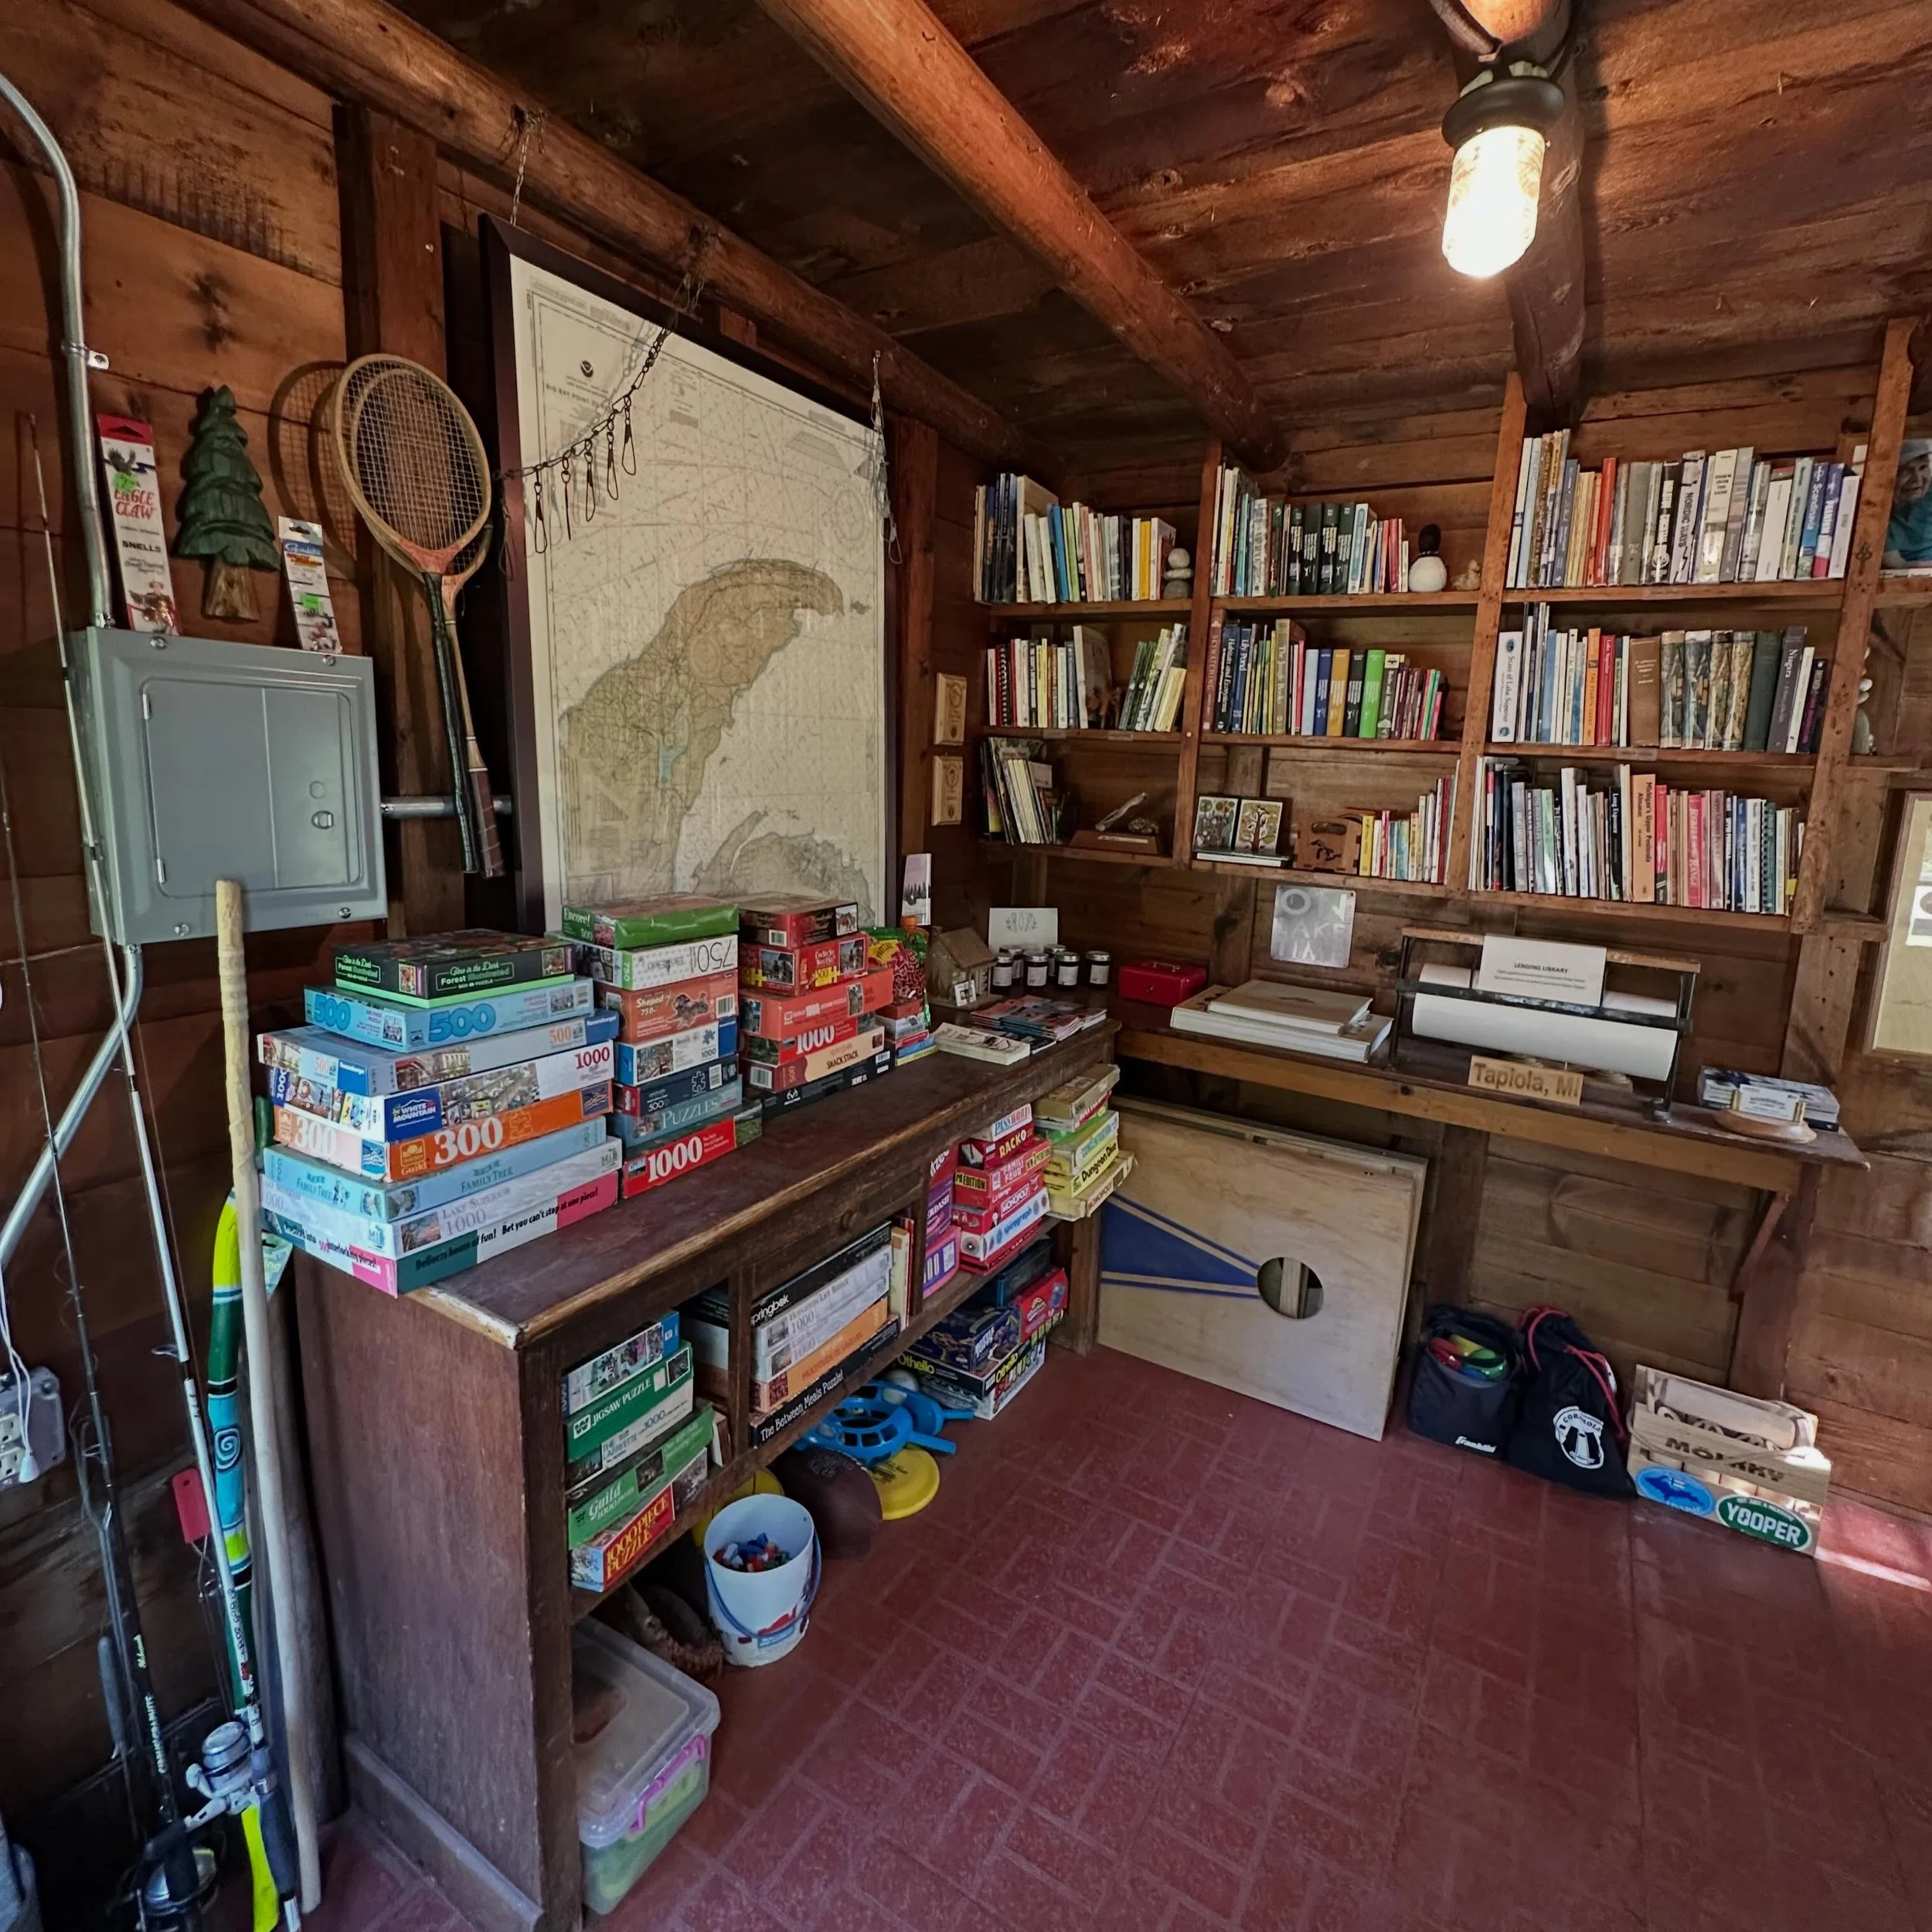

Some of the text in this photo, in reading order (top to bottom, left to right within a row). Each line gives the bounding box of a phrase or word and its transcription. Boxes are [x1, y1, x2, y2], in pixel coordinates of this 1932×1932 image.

[116, 501, 154, 519] CLAW
[1678, 492, 1694, 548] NORDIC WAYS
[1807, 483, 1822, 530] Scandinavia
[122, 540, 161, 553] SNELLS
[1207, 634, 1219, 690] SKYWATCHING
[1240, 652, 1248, 671] Pond
[1784, 648, 1798, 679] Niagara
[1690, 808, 1699, 839] REBELS
[563, 907, 590, 926] Encore!
[697, 940, 733, 973] 750
[1514, 963, 1541, 971] LENDING
[440, 975, 466, 985] Forest
[314, 994, 351, 1031] 500
[636, 994, 665, 1009] Shaped
[429, 1003, 496, 1042] 500
[549, 1026, 572, 1042] 500
[701, 1047, 717, 1060] 1000
[796, 1025, 835, 1055] 1000
[574, 1046, 611, 1070] 1000
[826, 1049, 859, 1070] SNACK STACK
[1474, 1062, 1580, 1098] Tapiola, MI
[393, 1106, 437, 1124] MOUNTAIN
[401, 1103, 427, 1115] WHITE
[662, 1097, 719, 1130] PUZZLES
[994, 1105, 1031, 1137] PASSWORD
[294, 1116, 338, 1158] 300
[434, 1117, 503, 1165] 300
[648, 1136, 703, 1183] 1000
[1081, 1143, 1117, 1182] Dungeon Dice
[297, 1178, 318, 1196] FAMILY
[461, 1172, 494, 1192] FAMILY
[493, 1166, 514, 1181] TREE
[963, 1175, 986, 1191] EDITION
[265, 1190, 284, 1209] 000
[469, 1186, 511, 1207] SUPERIOR
[1002, 1185, 1029, 1212] MONOPOLY
[415, 1247, 447, 1271] Delivers
[449, 1240, 471, 1257] hours
[471, 1234, 481, 1248] of
[480, 1229, 497, 1245] fun!
[502, 1223, 515, 1235] Bet
[515, 1218, 528, 1231] you
[529, 1210, 545, 1224] can't
[546, 1204, 560, 1218] stop
[567, 1197, 580, 1206] one
[580, 1187, 599, 1205] piece!
[446, 1209, 487, 1237] 1000
[1004, 1206, 1032, 1235] spirograph
[791, 1309, 815, 1335] 1000
[896, 1353, 935, 1375] Othello
[995, 1352, 1019, 1383] Othello
[592, 1377, 651, 1427] JIGSAW PUZZLE
[760, 1369, 844, 1442] The Between Meals Puzzle!
[643, 1410, 666, 1430] 1000
[1455, 1435, 1498, 1454] Franklin
[588, 1481, 622, 1517] Guild
[605, 1495, 669, 1563] 1000 PIECE
[1726, 1501, 1802, 1546] YOOPER
[607, 1527, 653, 1580] PUZZLE
